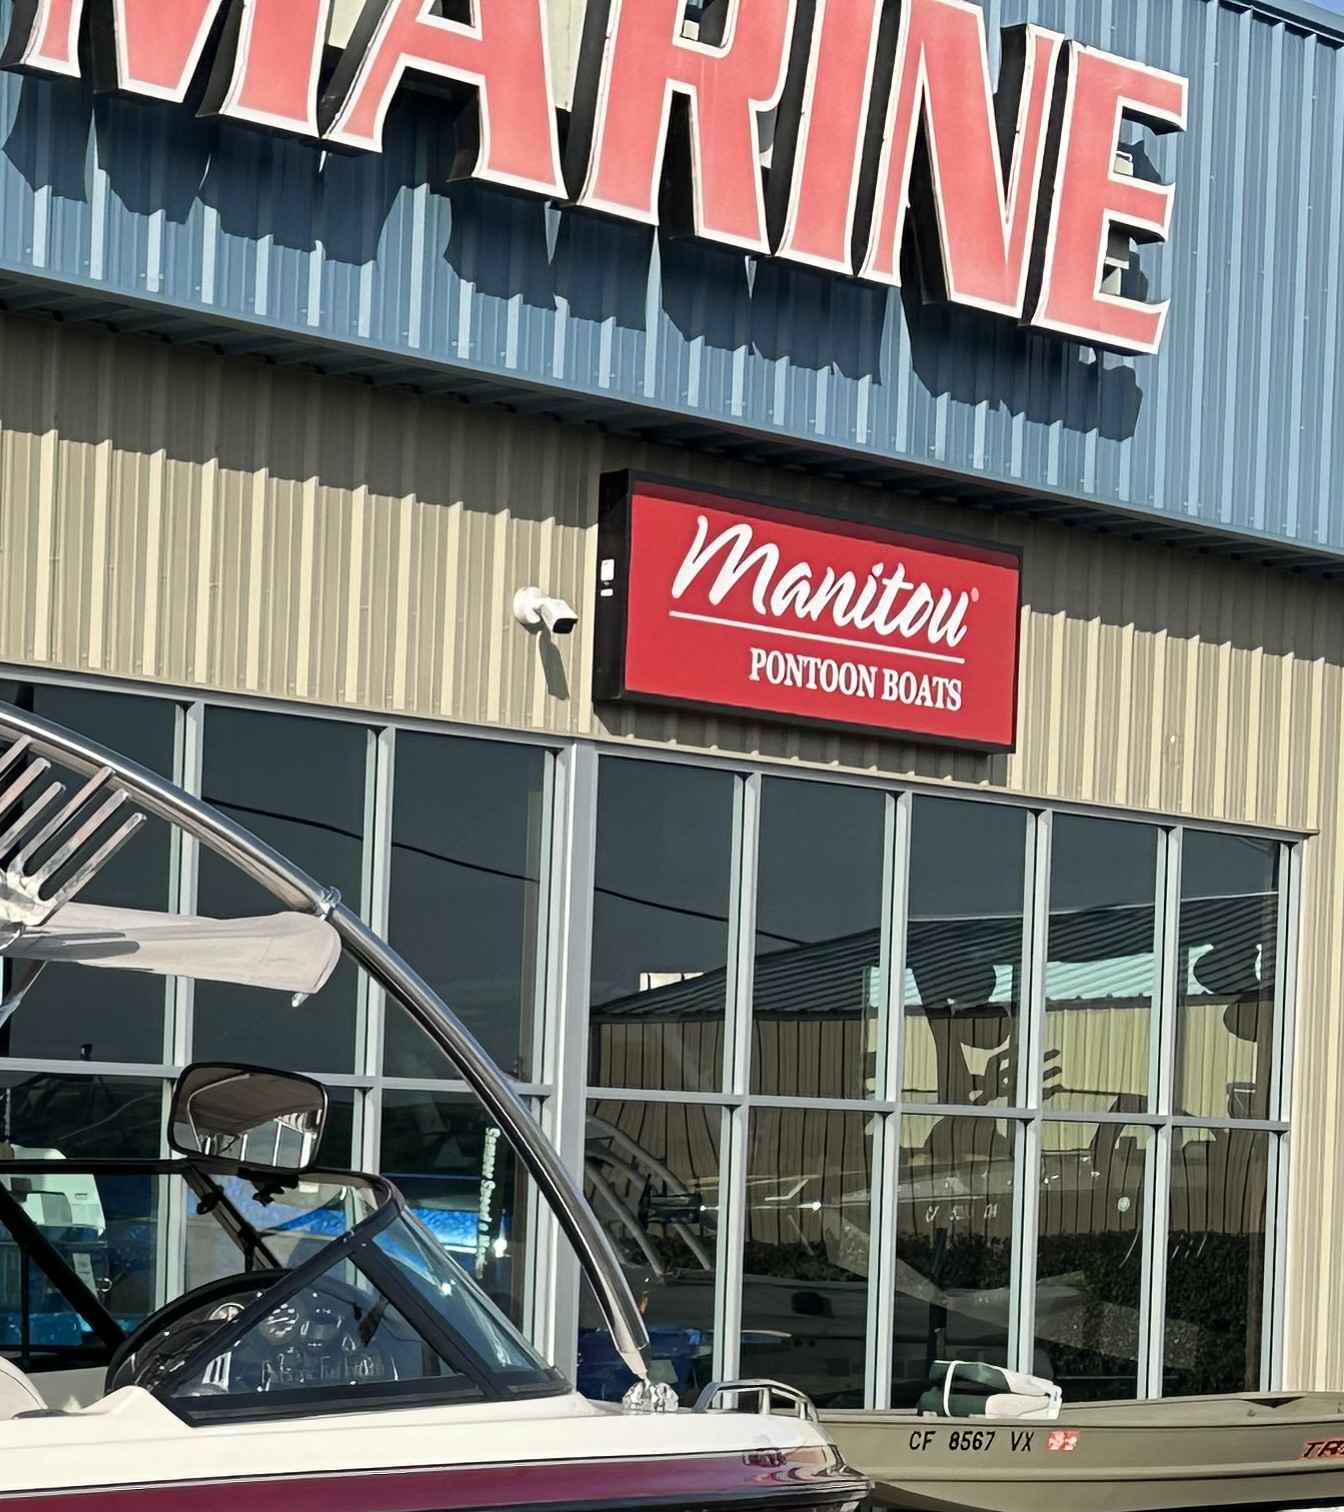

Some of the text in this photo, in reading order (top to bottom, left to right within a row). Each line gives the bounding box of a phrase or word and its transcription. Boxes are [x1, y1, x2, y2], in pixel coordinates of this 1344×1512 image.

[671, 515, 970, 647] Manitou
[749, 647, 963, 712] PONTOON BOATS
[909, 1430, 937, 1451] CF
[948, 1430, 996, 1451] 8567
[1010, 1430, 1035, 1452] VX
